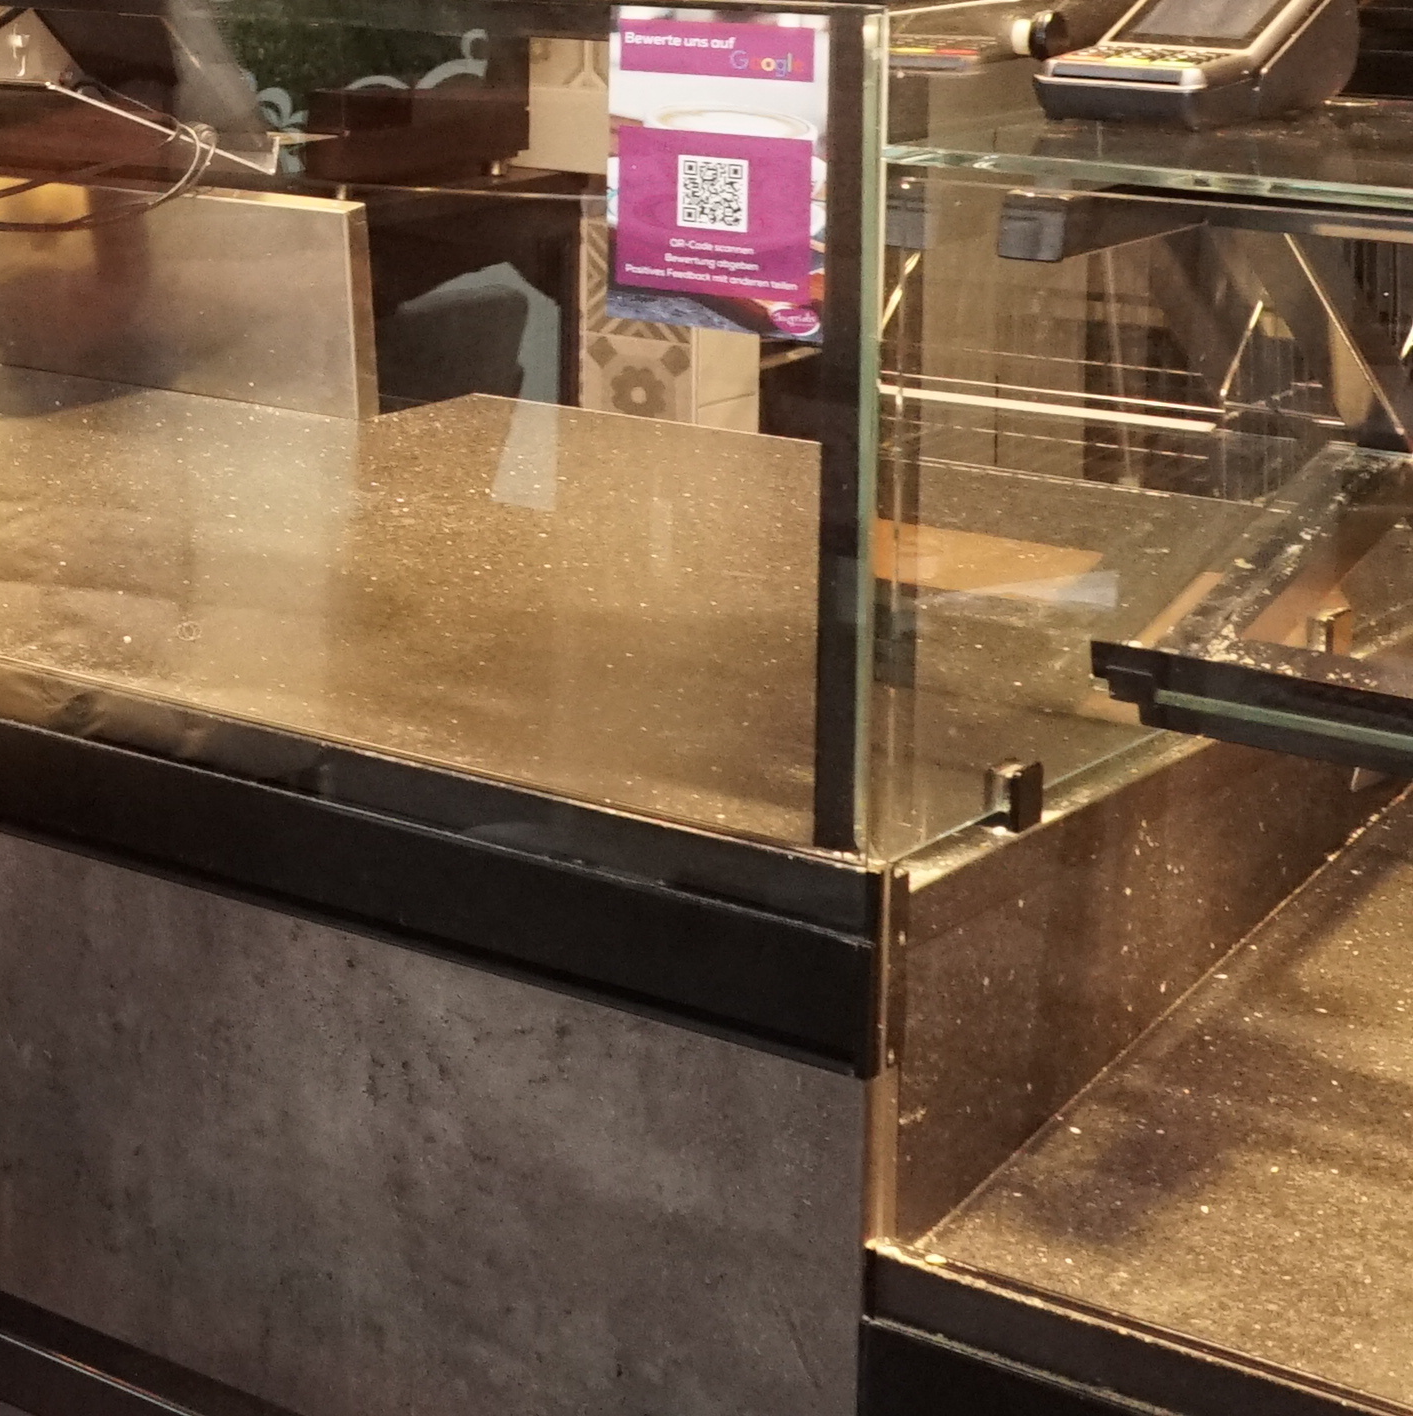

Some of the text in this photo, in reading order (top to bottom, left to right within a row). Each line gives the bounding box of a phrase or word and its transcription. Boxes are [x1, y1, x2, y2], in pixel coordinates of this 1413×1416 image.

[624, 31, 736, 49] Bewerte uns auf
[729, 50, 804, 77] Google
[669, 238, 714, 252] QR-Code
[664, 253, 716, 269] Bewertung
[625, 263, 665, 277] Positives
[666, 268, 712, 282] Feedback
